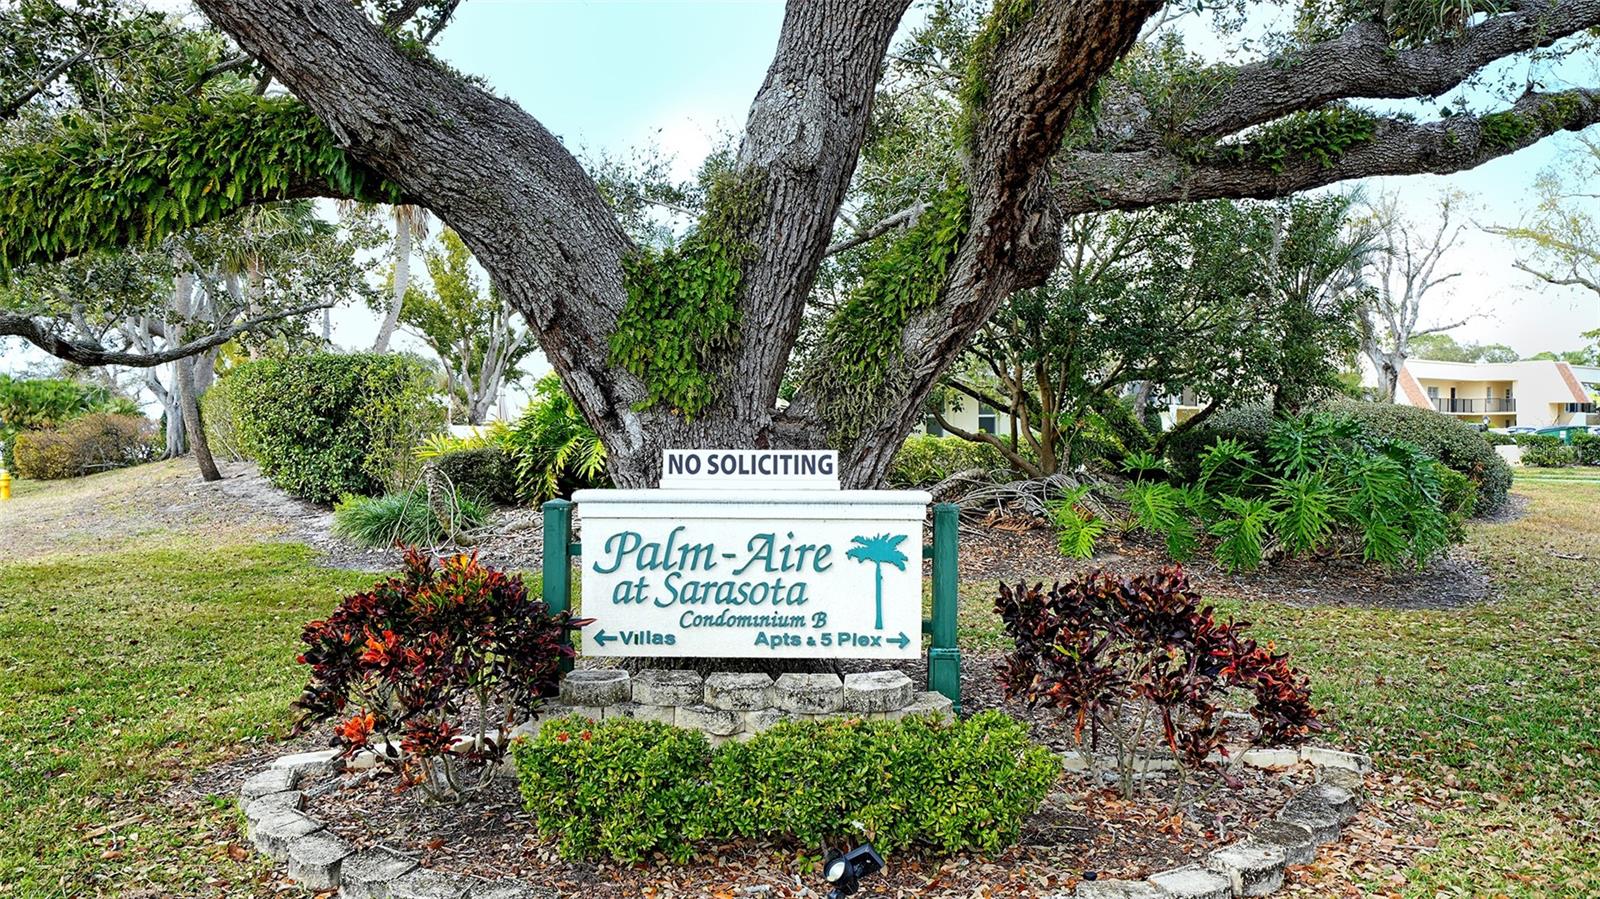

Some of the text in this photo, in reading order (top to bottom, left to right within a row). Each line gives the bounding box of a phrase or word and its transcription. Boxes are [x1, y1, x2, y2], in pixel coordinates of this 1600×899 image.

[668, 453, 834, 475] NO SOLICITING
[593, 526, 833, 576] Palm-Aire
[612, 571, 809, 608] at Sarasota
[679, 608, 827, 629] Condominium B
[619, 630, 676, 646] Villas
[754, 631, 882, 650] Apts & 5 Plex
